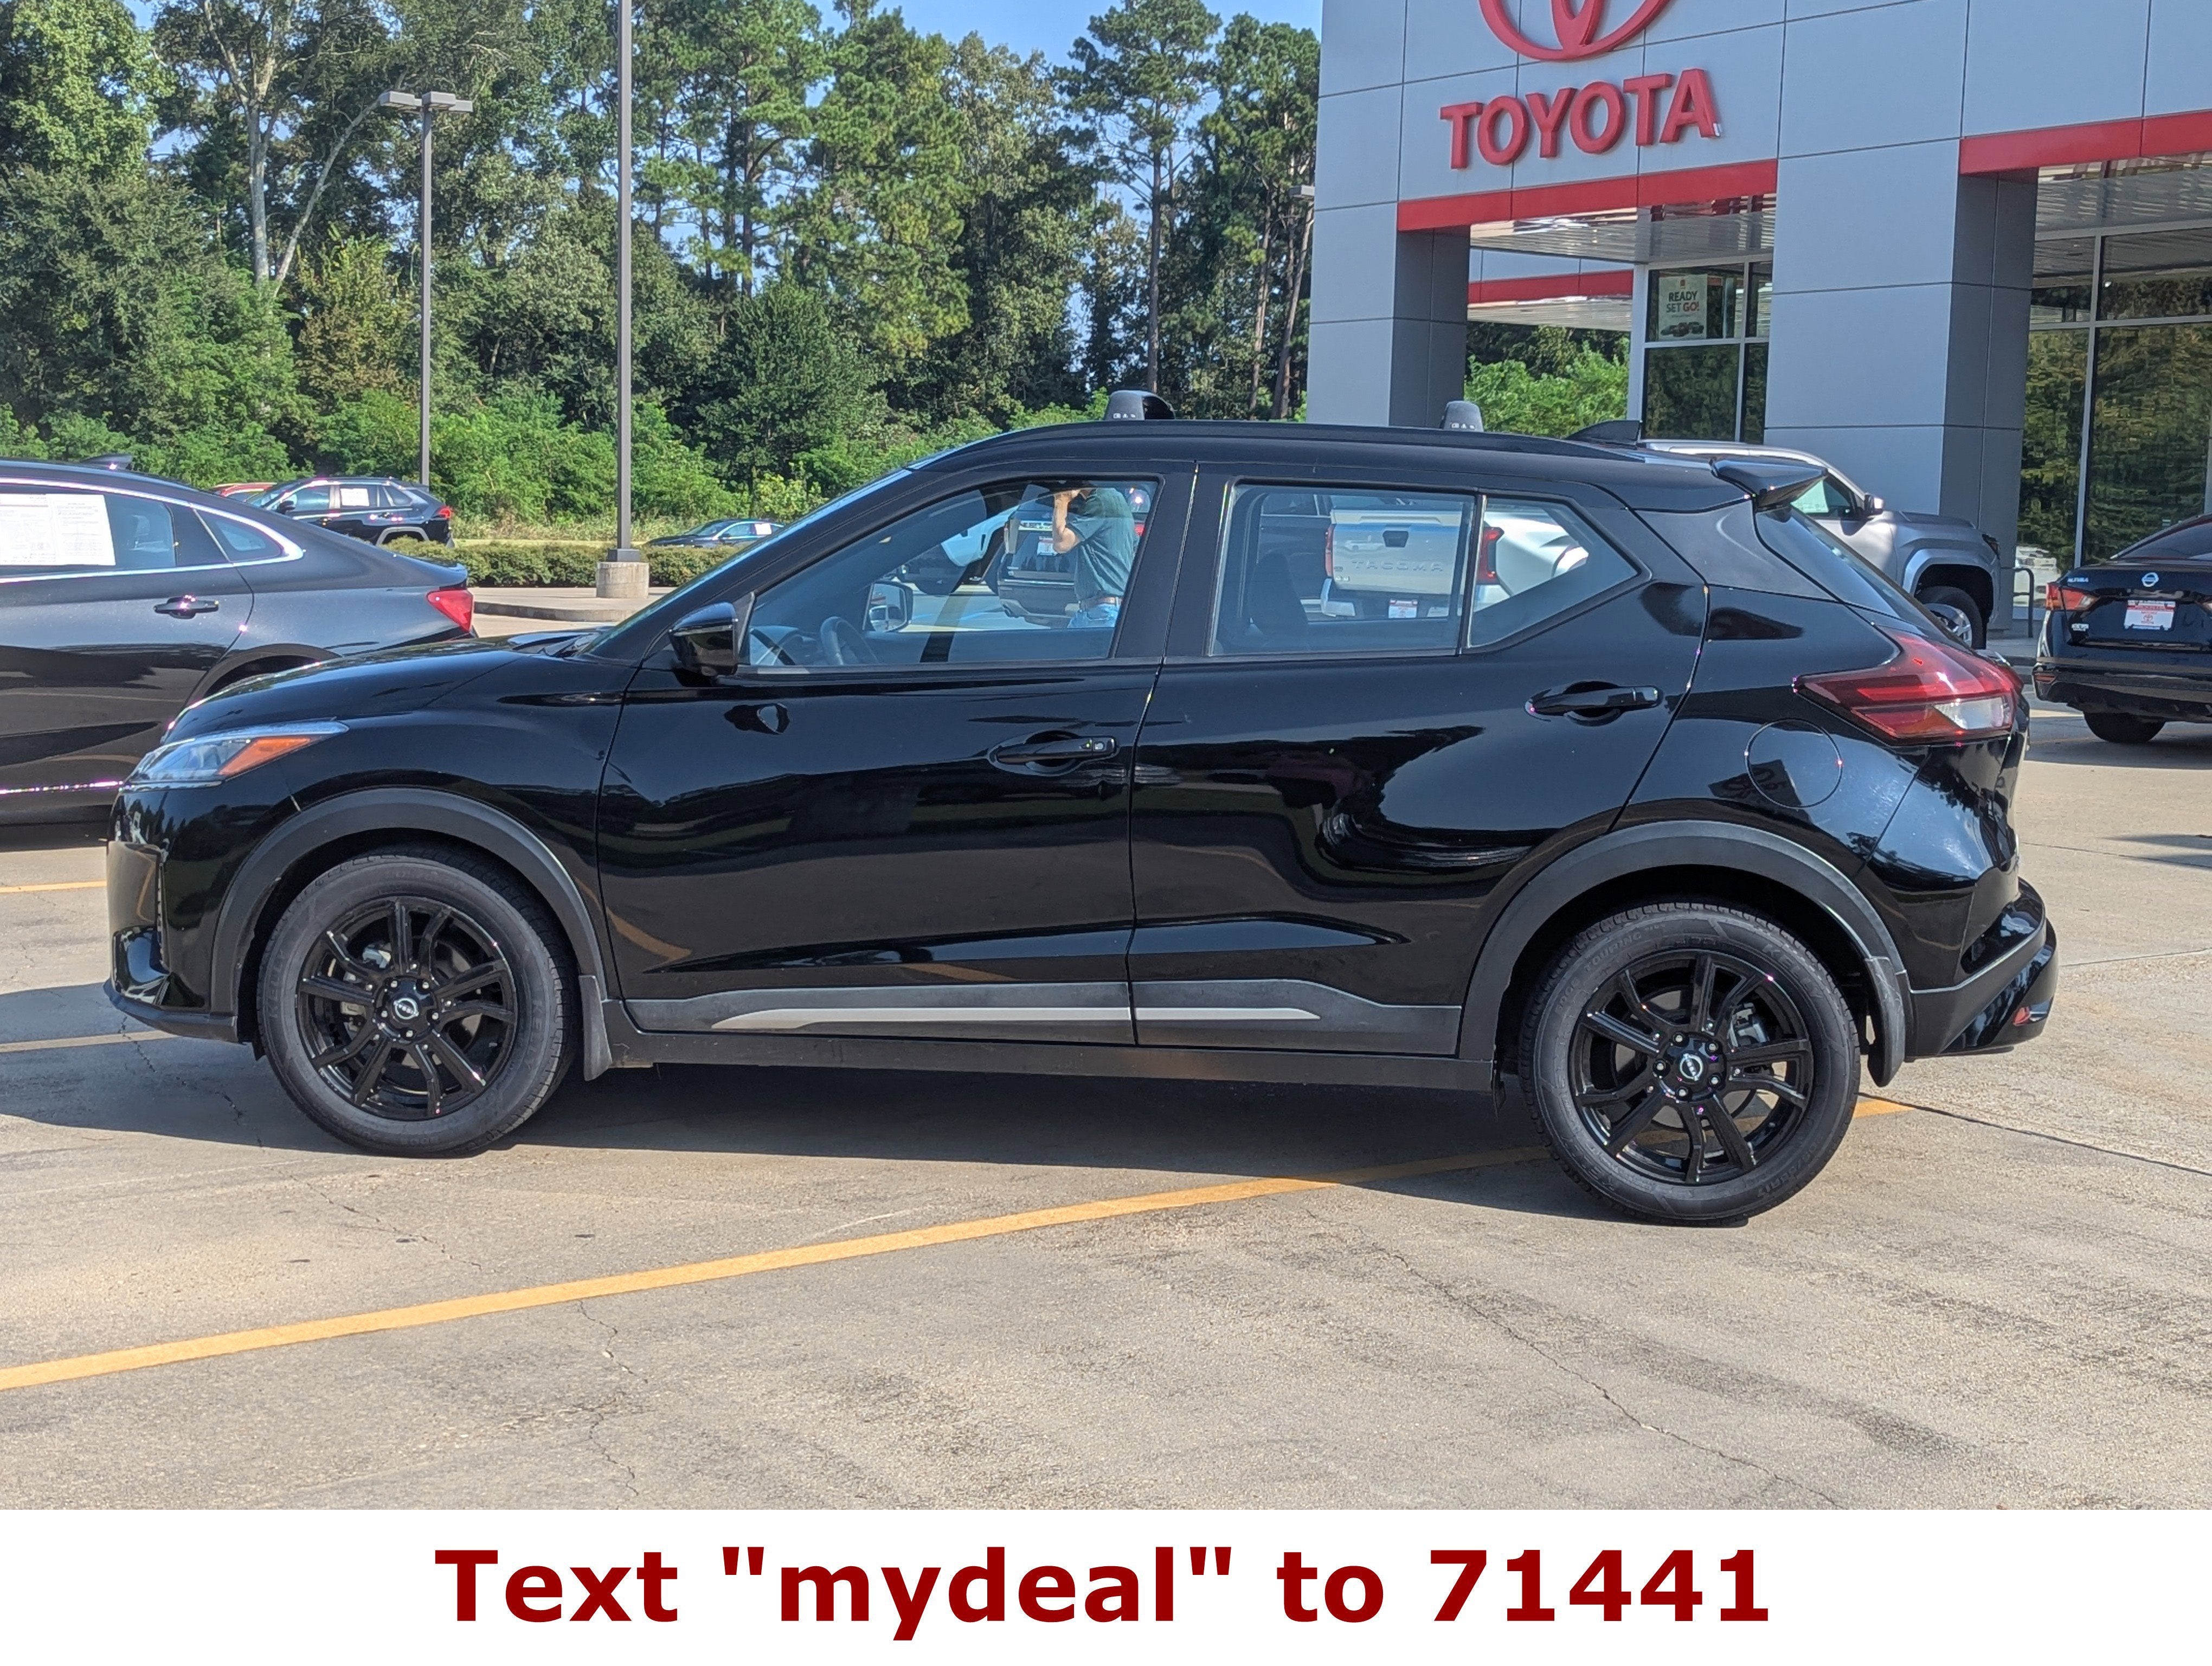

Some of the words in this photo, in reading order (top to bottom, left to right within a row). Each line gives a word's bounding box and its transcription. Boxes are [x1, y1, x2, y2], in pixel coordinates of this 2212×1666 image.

[1440, 68, 1721, 170] TOYOTA
[1669, 291, 1697, 302] READY
[1666, 303, 1681, 313] SET
[1683, 302, 1700, 312] GO!
[1352, 560, 1444, 572] TACOMA
[1761, 944, 1824, 998] KELLY
